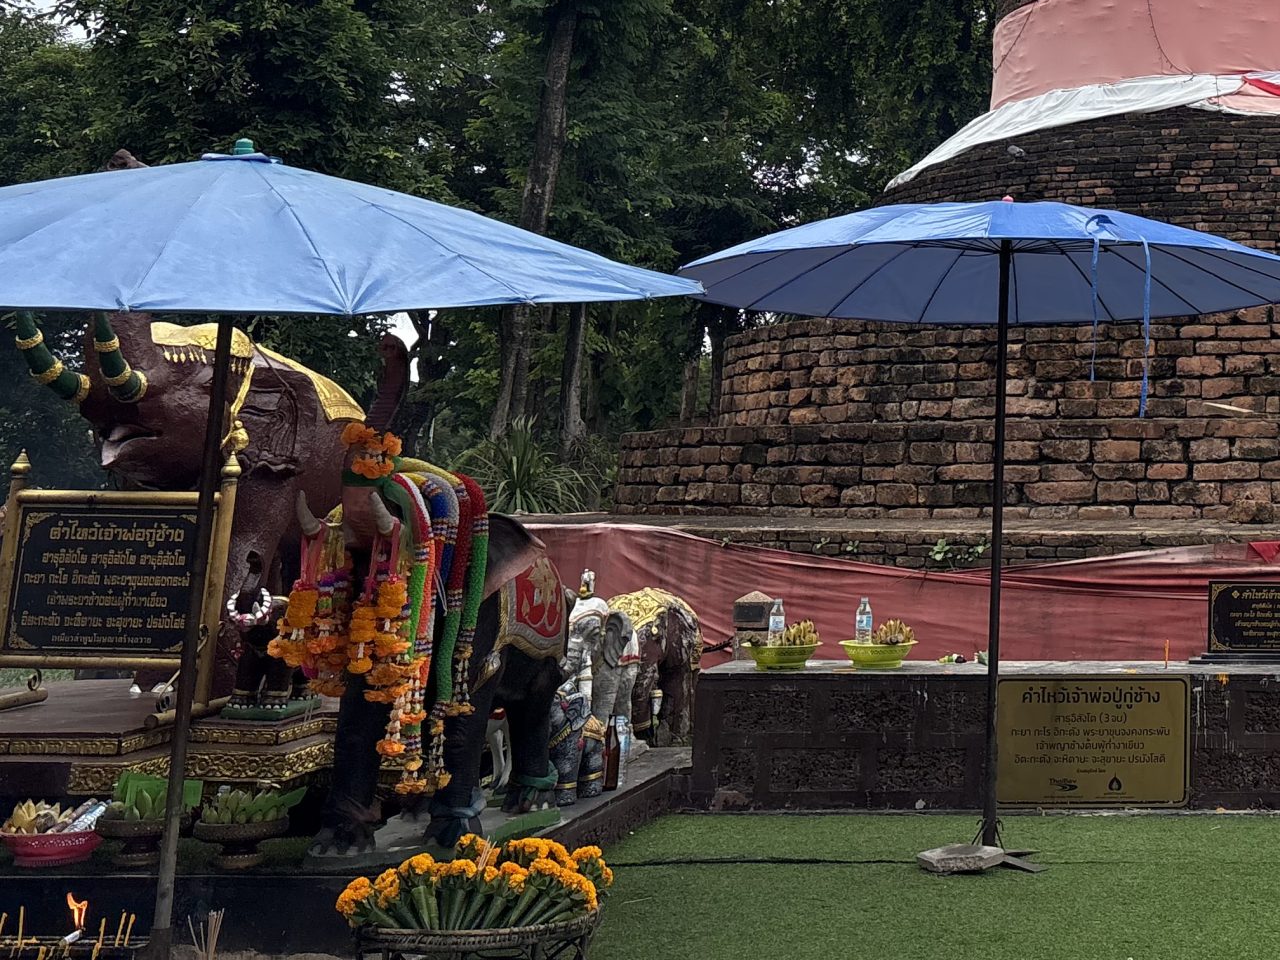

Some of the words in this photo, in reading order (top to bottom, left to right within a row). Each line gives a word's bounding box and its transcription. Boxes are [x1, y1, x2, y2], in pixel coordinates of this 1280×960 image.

[50, 520, 184, 547] คำไหว้เจ้าพ่อกู่ช้าง
[1022, 686, 1160, 709] คำไหว้เจ้าพ่อปู่กู่ช้าง
